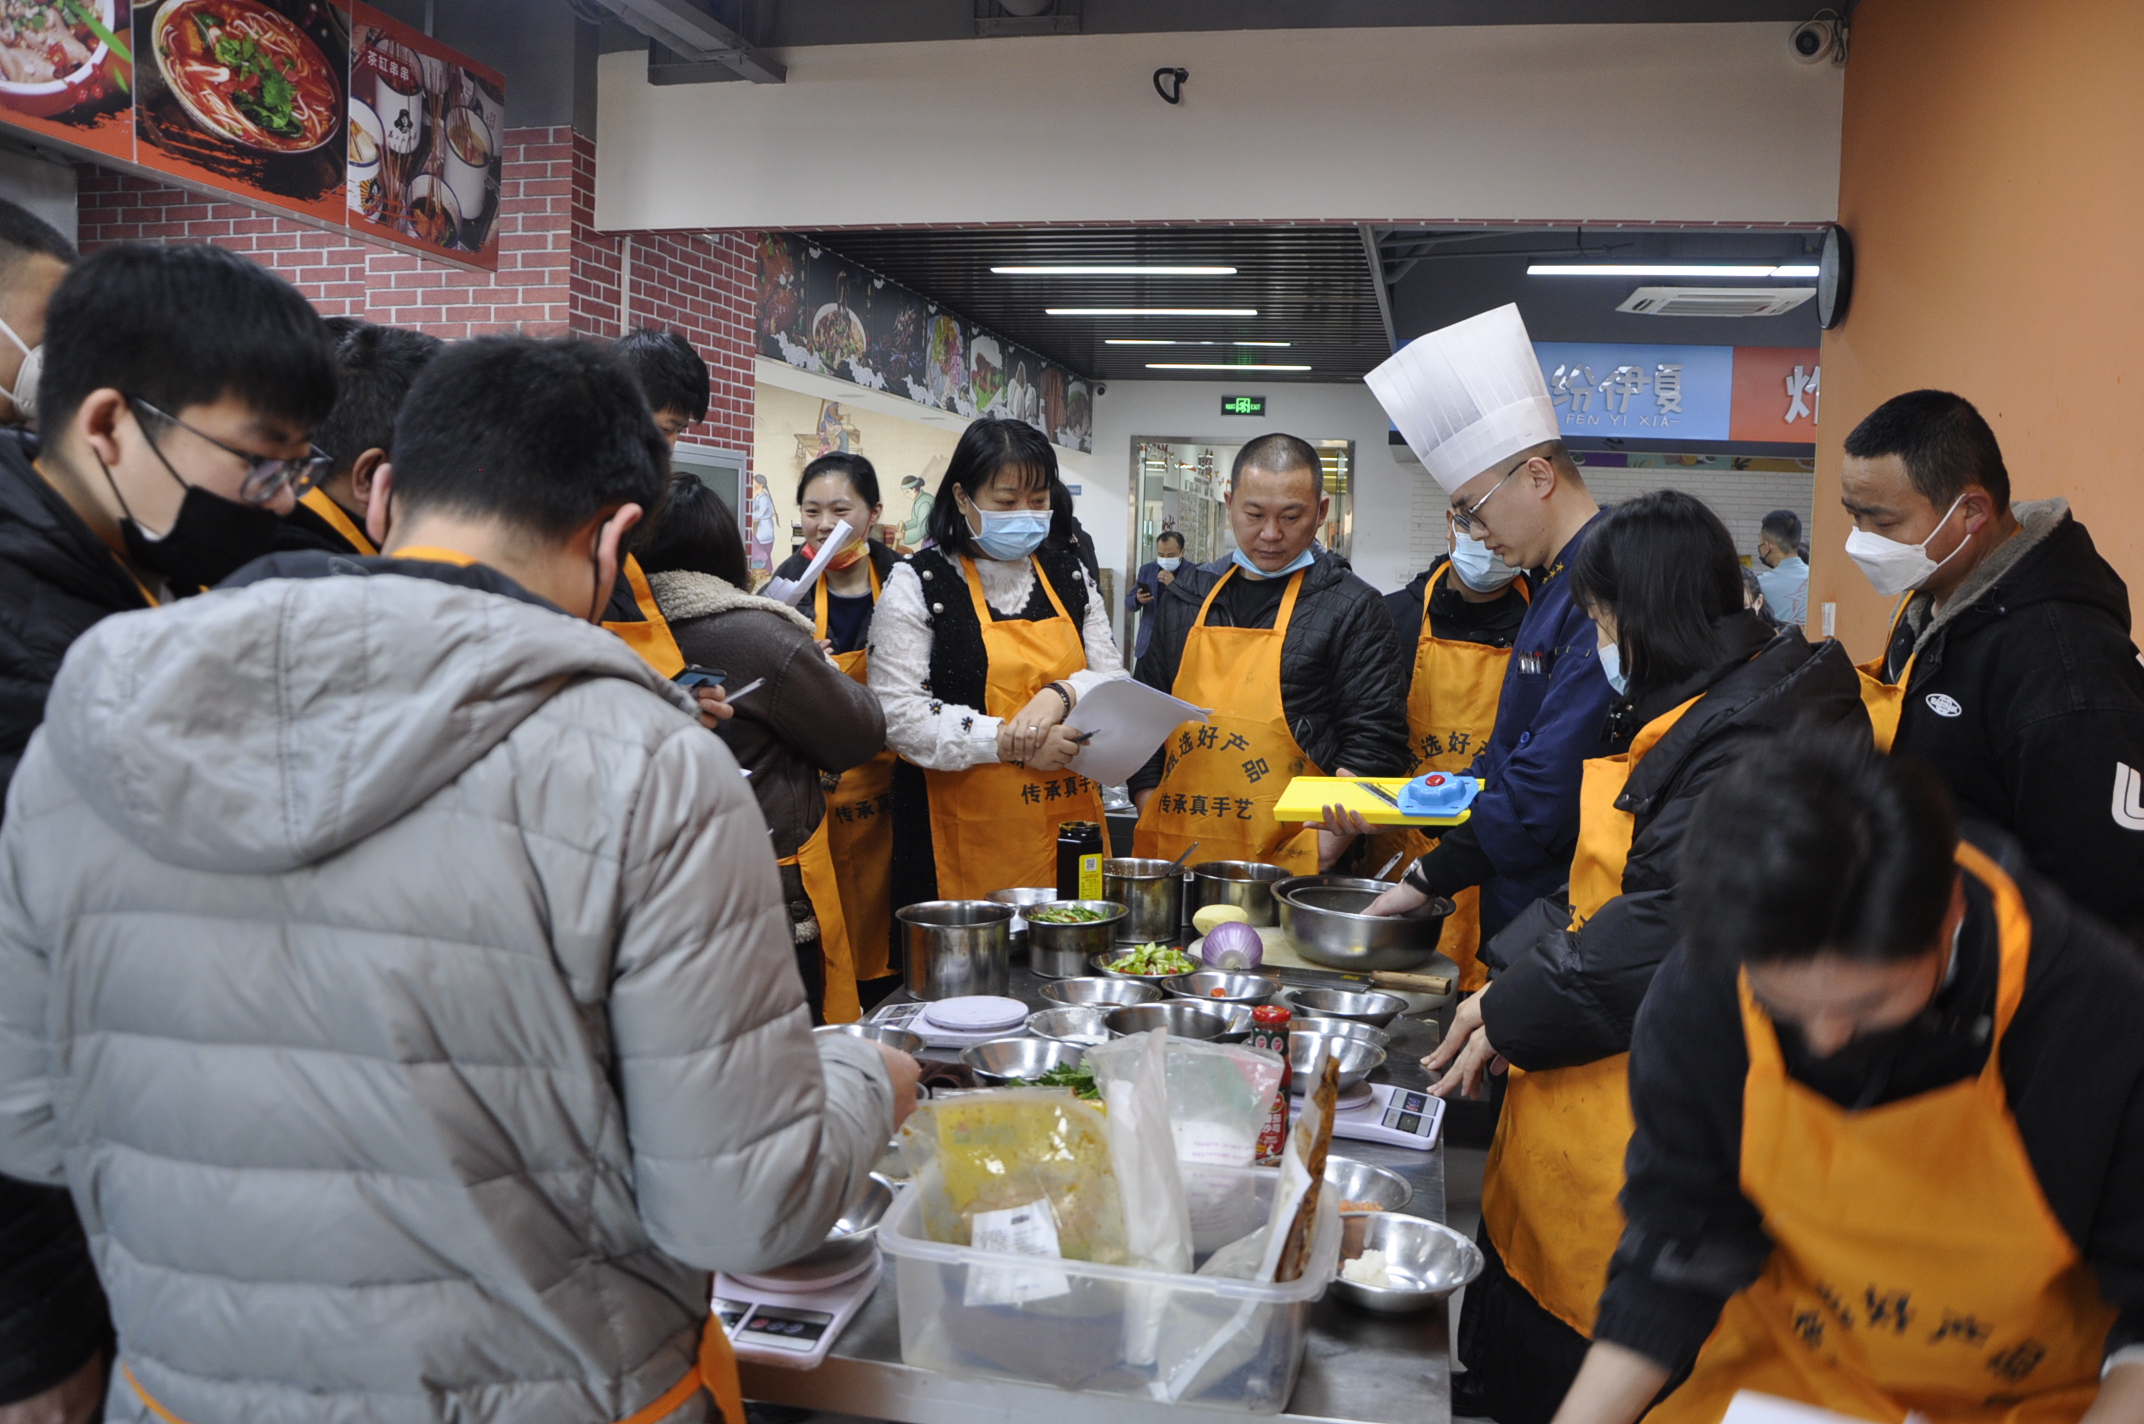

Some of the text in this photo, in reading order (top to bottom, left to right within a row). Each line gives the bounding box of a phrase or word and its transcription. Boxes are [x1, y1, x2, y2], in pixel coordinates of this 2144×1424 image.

[367, 50, 410, 82] 茶缸串串
[1550, 363, 1684, 415] 纷伊夏
[1565, 413, 1600, 427] FEN
[1609, 414, 1628, 427] YI
[1158, 792, 1254, 821] 传承真手艺
